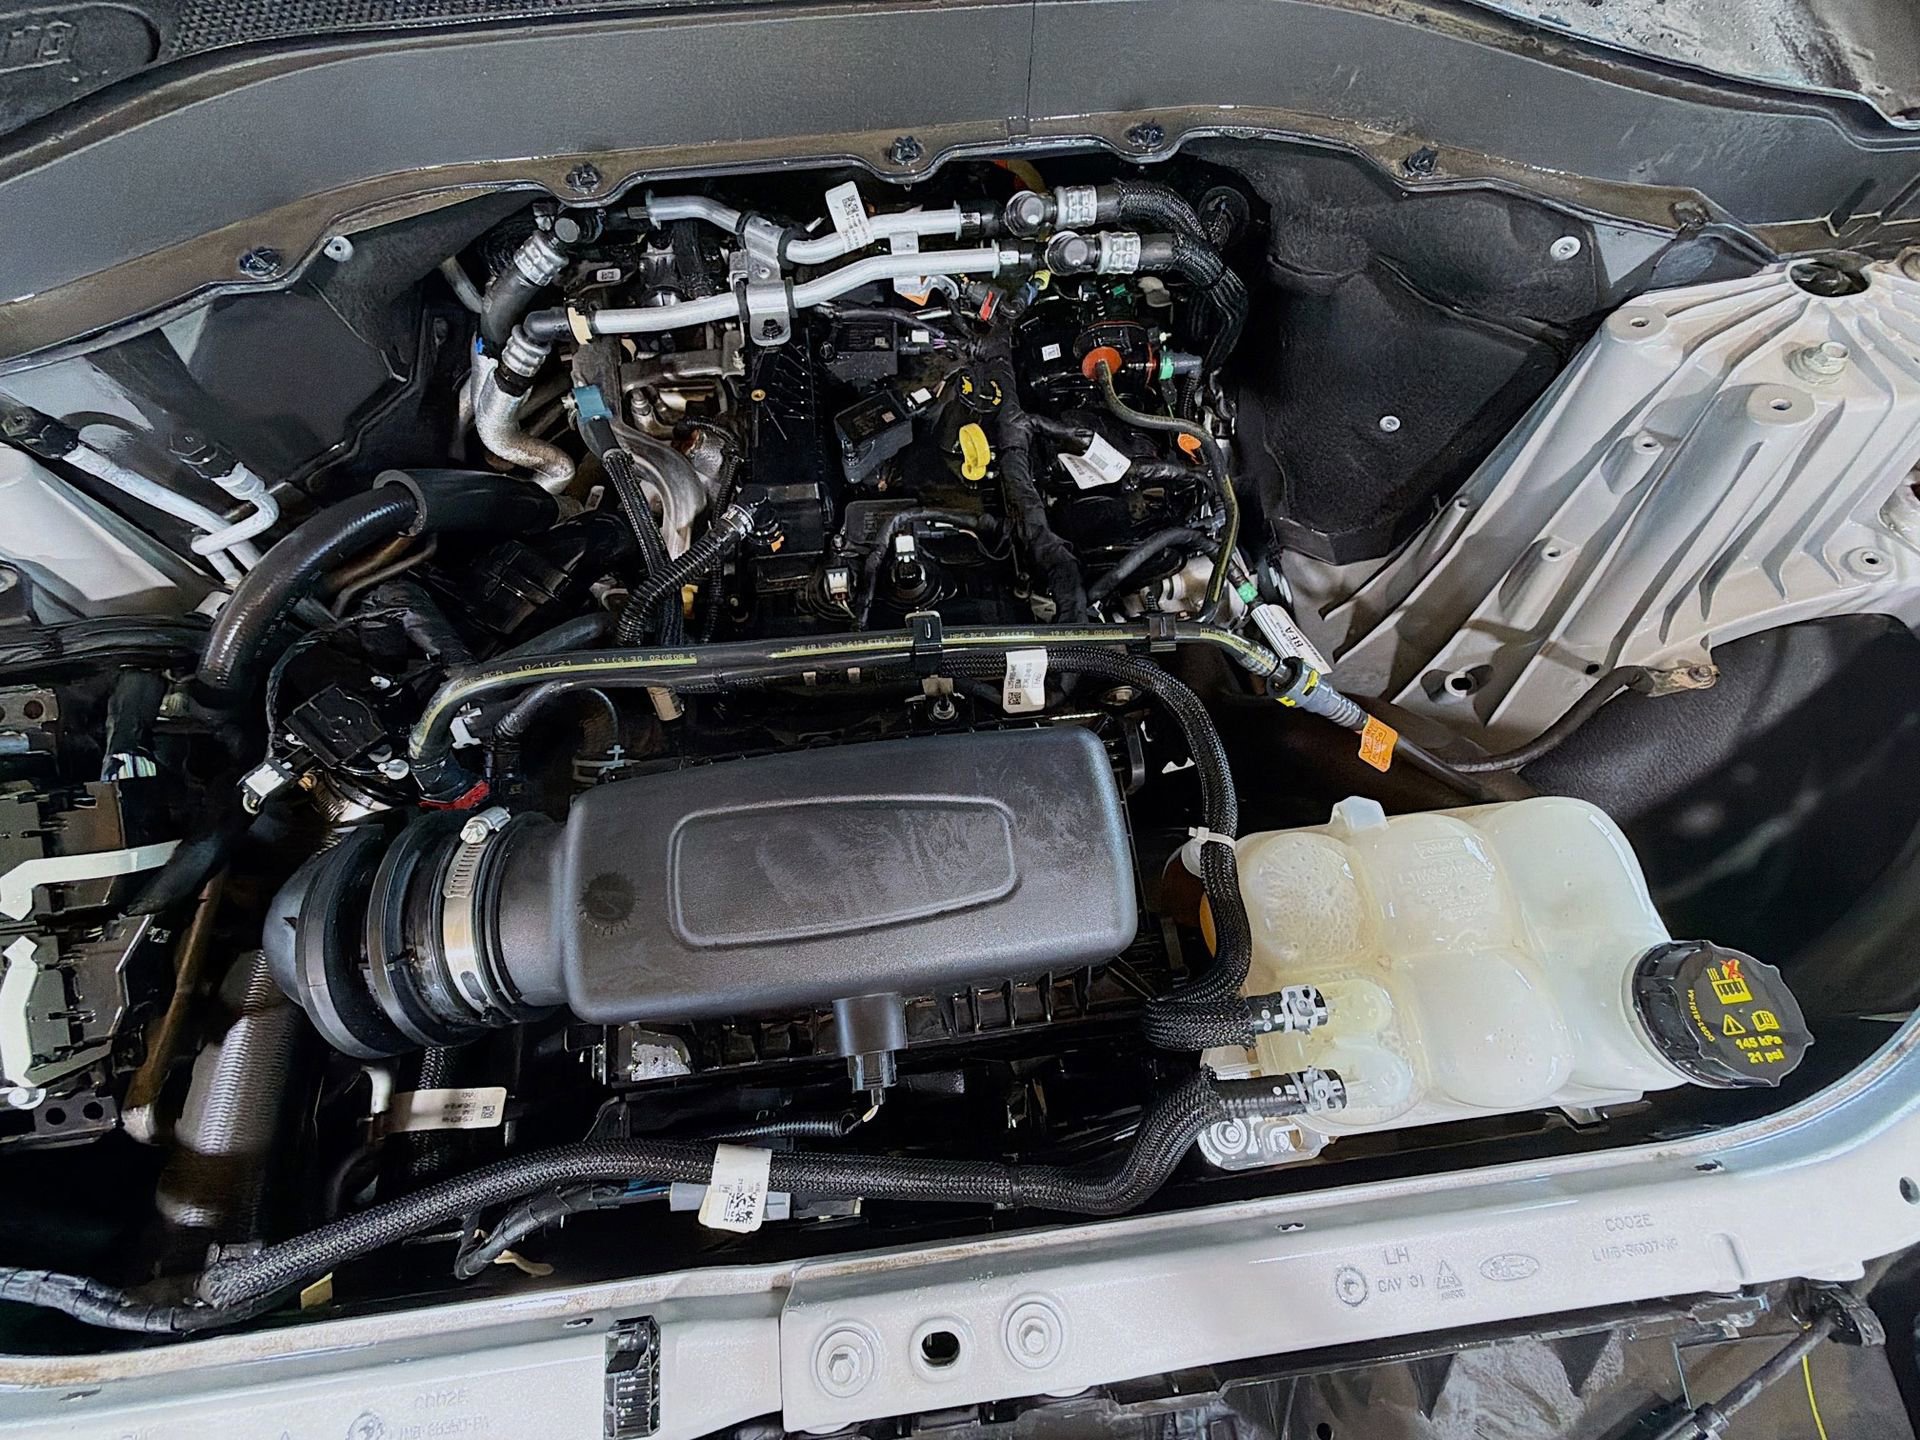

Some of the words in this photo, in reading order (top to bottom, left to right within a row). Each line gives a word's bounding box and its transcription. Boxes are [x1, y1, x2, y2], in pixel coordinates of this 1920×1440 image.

[1735, 1037, 1759, 1050] 145
[1757, 1035, 1783, 1047] kPa
[1747, 1051, 1764, 1064] 21
[1764, 1048, 1785, 1064] psi
[1382, 1246, 1410, 1265] LH
